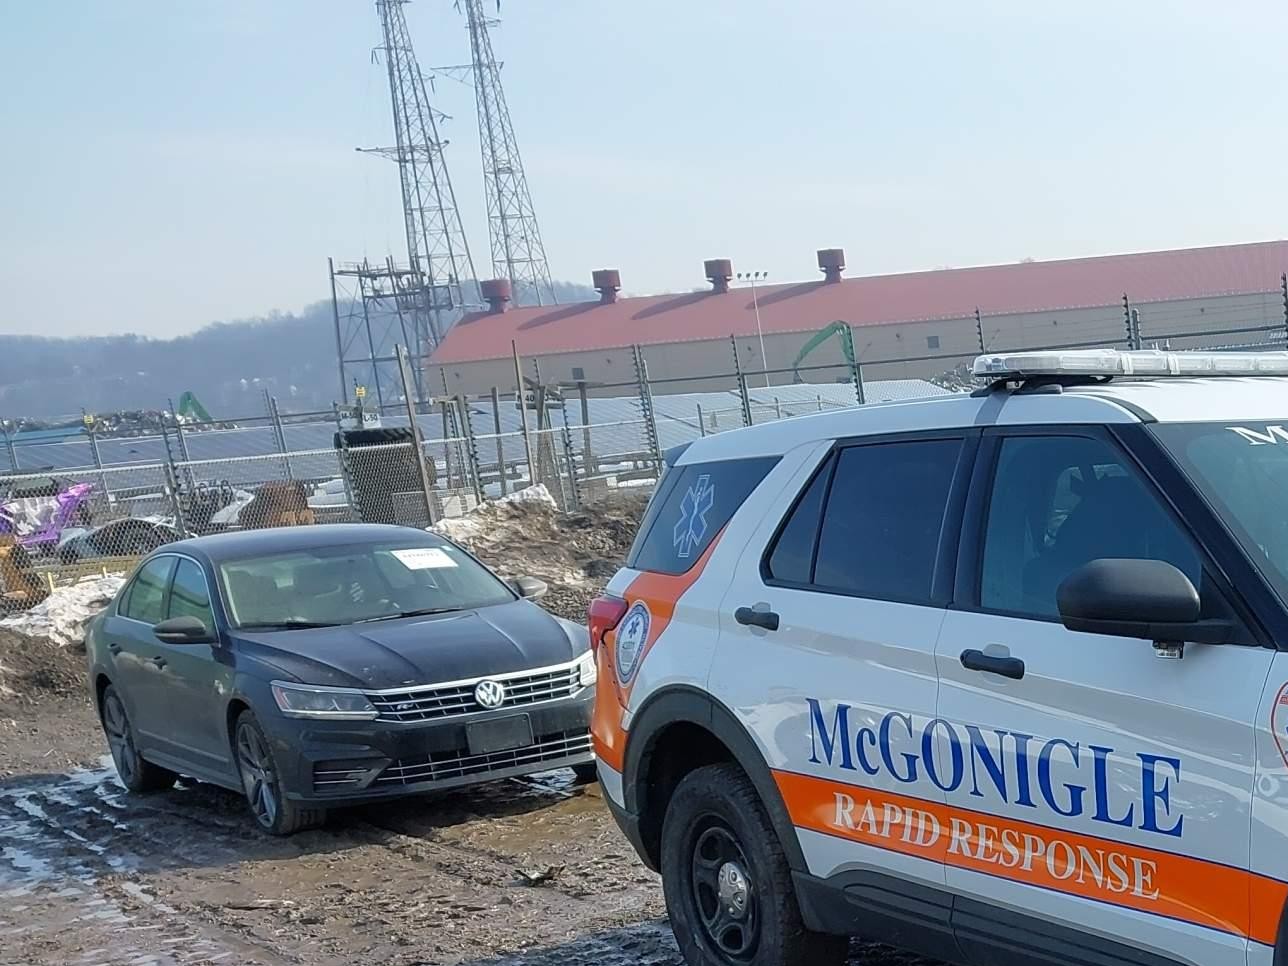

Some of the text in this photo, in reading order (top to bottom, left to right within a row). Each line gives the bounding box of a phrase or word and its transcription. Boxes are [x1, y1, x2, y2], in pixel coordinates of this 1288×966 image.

[805, 697, 1184, 839] McGONIGLE
[832, 791, 1160, 901] RAPID RESPONSE
